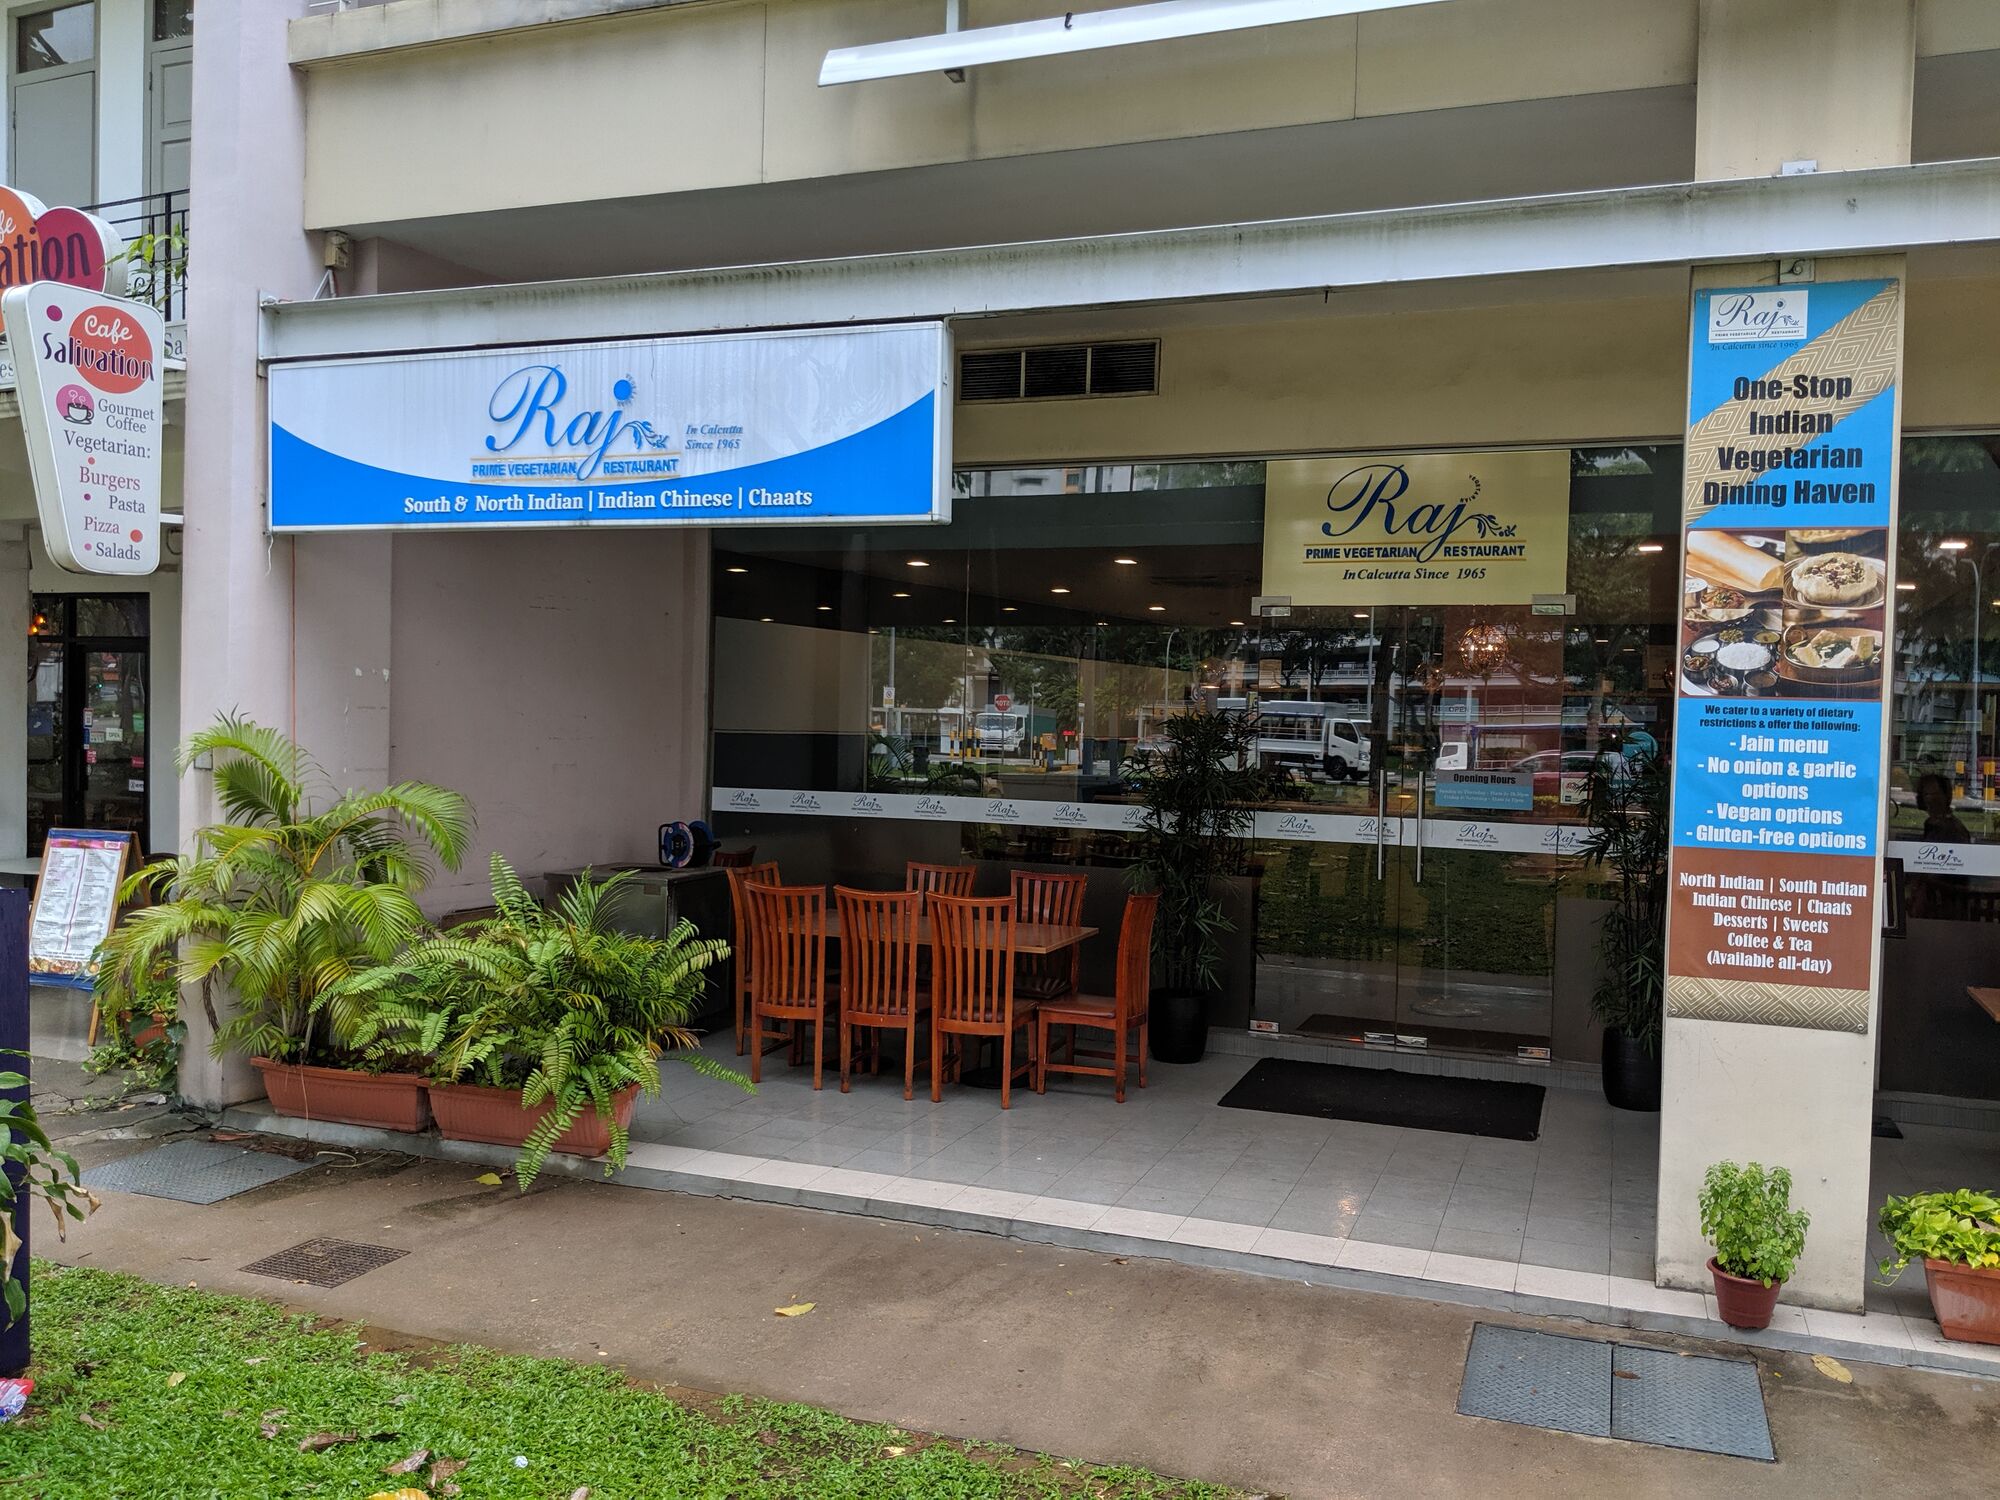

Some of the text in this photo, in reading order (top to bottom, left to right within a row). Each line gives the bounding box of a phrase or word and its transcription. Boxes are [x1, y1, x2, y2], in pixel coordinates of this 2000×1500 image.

[1715, 293, 1784, 338] Raj
[84, 315, 133, 344] Cafe
[164, 330, 187, 357] Sa
[1722, 342, 1755, 351] Calcutta
[1760, 341, 1777, 349] since
[43, 332, 155, 381] Salivation
[1734, 374, 1852, 400] One-Stop
[98, 398, 155, 421] Gourmet
[106, 414, 147, 434] Coffee
[486, 364, 634, 481] Raj
[686, 424, 744, 435] In Calcutta
[1750, 411, 1833, 435] Indian
[64, 430, 151, 460] Vegetarian:
[685, 439, 741, 450] Since 1965
[472, 458, 679, 477] PRIME VEGETARIAN RESTAURANT
[1718, 445, 1862, 472] Vegetarian
[79, 466, 141, 492] Burgers
[108, 494, 146, 515] Pasta
[404, 495, 450, 513] South
[454, 494, 468, 510] &
[475, 493, 523, 511] North
[527, 491, 584, 510] Indian
[597, 488, 656, 509] Indian
[660, 487, 732, 507] Chinese
[748, 486, 812, 506] Chaats
[1704, 480, 1875, 508] Dining Haven
[1322, 464, 1467, 563] Raj
[84, 516, 120, 535] Pizza
[96, 542, 141, 561] Salads
[1306, 545, 1525, 559] PRIME VEGETARIAN RESTAURANT
[1343, 568, 1486, 580] In Calcutta Since 1965
[1705, 704, 1854, 719] We cater to a variety of dietary
[1700, 718, 1860, 732] restrictions & offer the following:
[1740, 735, 1774, 752] Jain
[1778, 738, 1828, 754] menu
[1708, 757, 1730, 774] No
[1734, 758, 1784, 776] onion
[1787, 761, 1800, 776] &
[1803, 762, 1856, 778] garlic
[1454, 774, 1516, 784] Opening Hours
[1742, 782, 1808, 800] options
[853, 794, 876, 811] Raj
[917, 797, 940, 814] Raj
[988, 801, 1013, 818] Raj
[1056, 804, 1081, 821] Raj
[1280, 815, 1308, 833] Raj
[1717, 803, 1771, 822] Vegan
[1775, 806, 1842, 824] options
[1459, 823, 1490, 842] Raj
[1696, 826, 1795, 846] Gluten-free
[1799, 831, 1866, 849] options
[1918, 845, 1953, 866] Raj
[1680, 872, 1715, 888] North
[1720, 874, 1764, 890] Indian
[1780, 878, 1817, 894] South
[1822, 880, 1867, 896] Indian
[1692, 892, 1736, 908] Indian
[1740, 895, 1792, 912] Chinese
[1808, 900, 1852, 916] Chaats
[1713, 912, 1768, 930] Desserts
[1783, 917, 1828, 934] Sweets
[1728, 932, 1812, 952] Coffee & Tea
[1707, 950, 1832, 974] (Available all-day)
